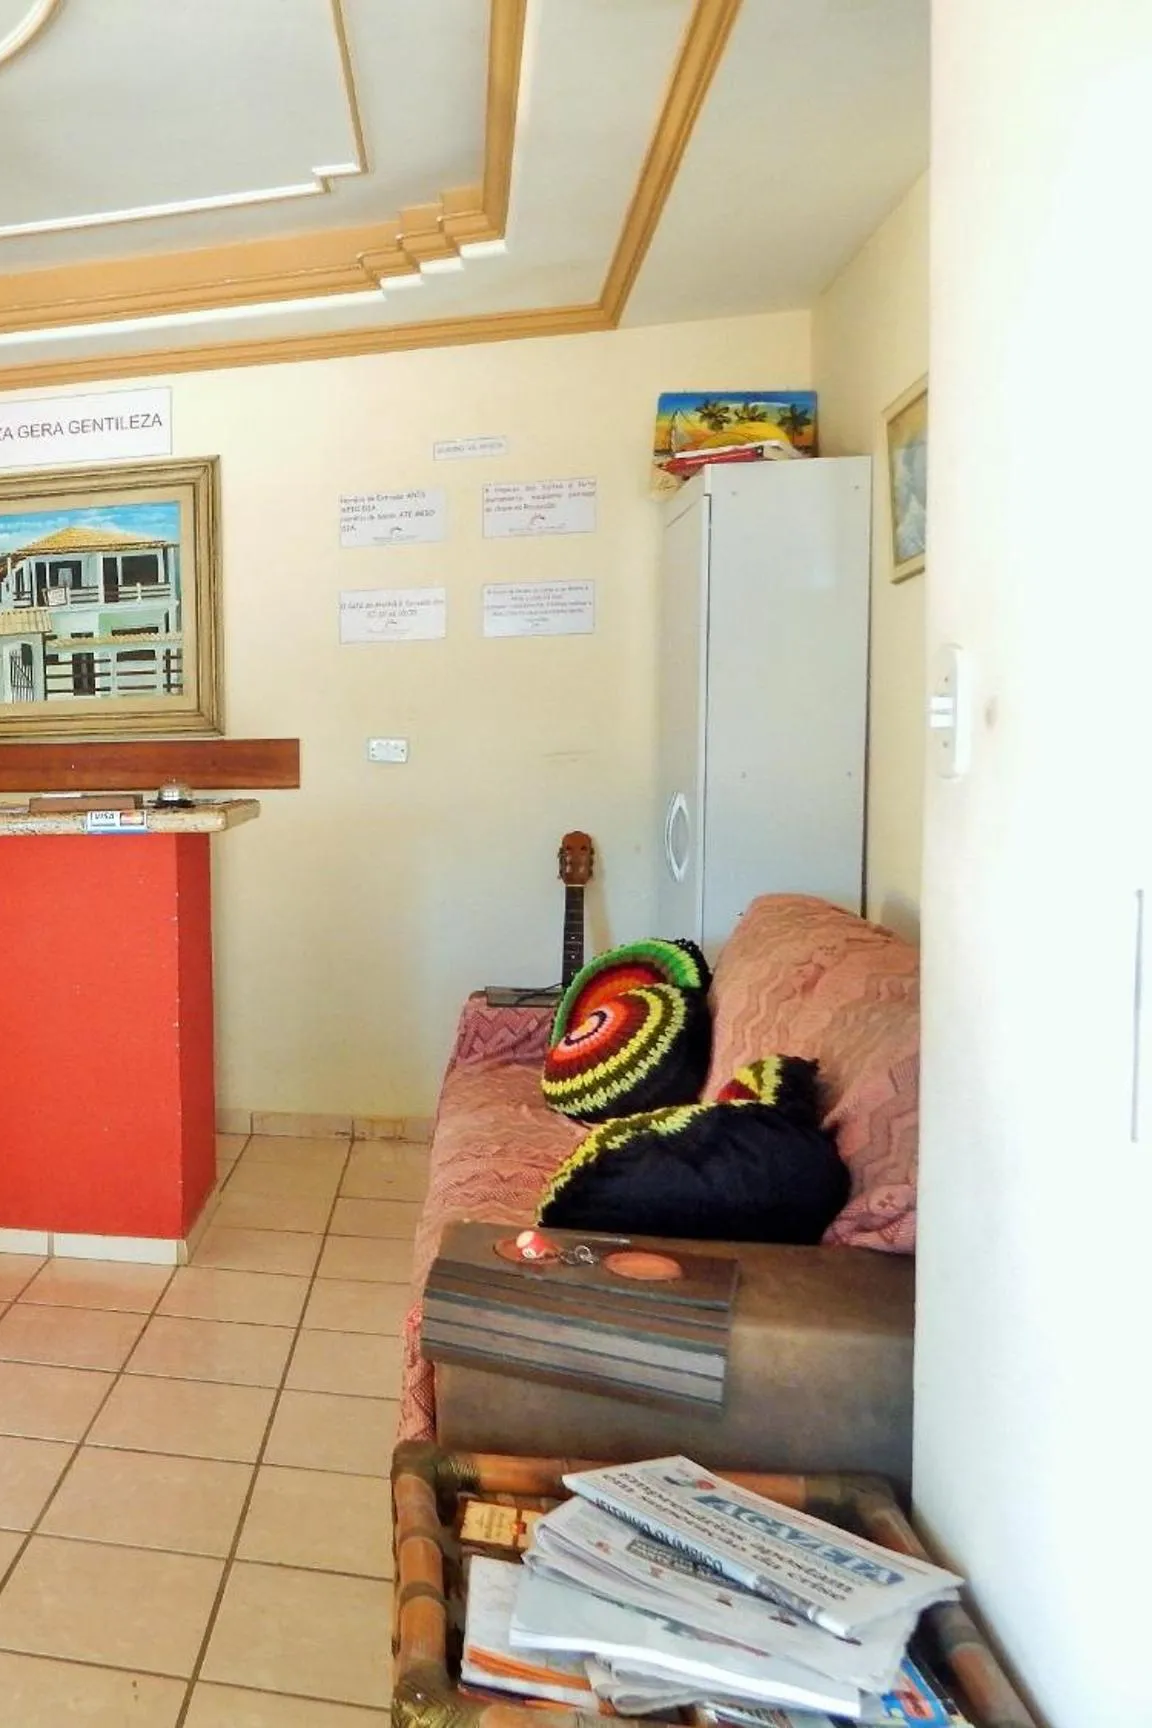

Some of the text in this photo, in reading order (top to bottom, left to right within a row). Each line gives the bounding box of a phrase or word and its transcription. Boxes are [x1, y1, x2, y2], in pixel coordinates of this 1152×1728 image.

[17, 422, 64, 440] GERA
[68, 412, 163, 435] GENTILEZA
[734, 1507, 901, 1586] GAZETA
